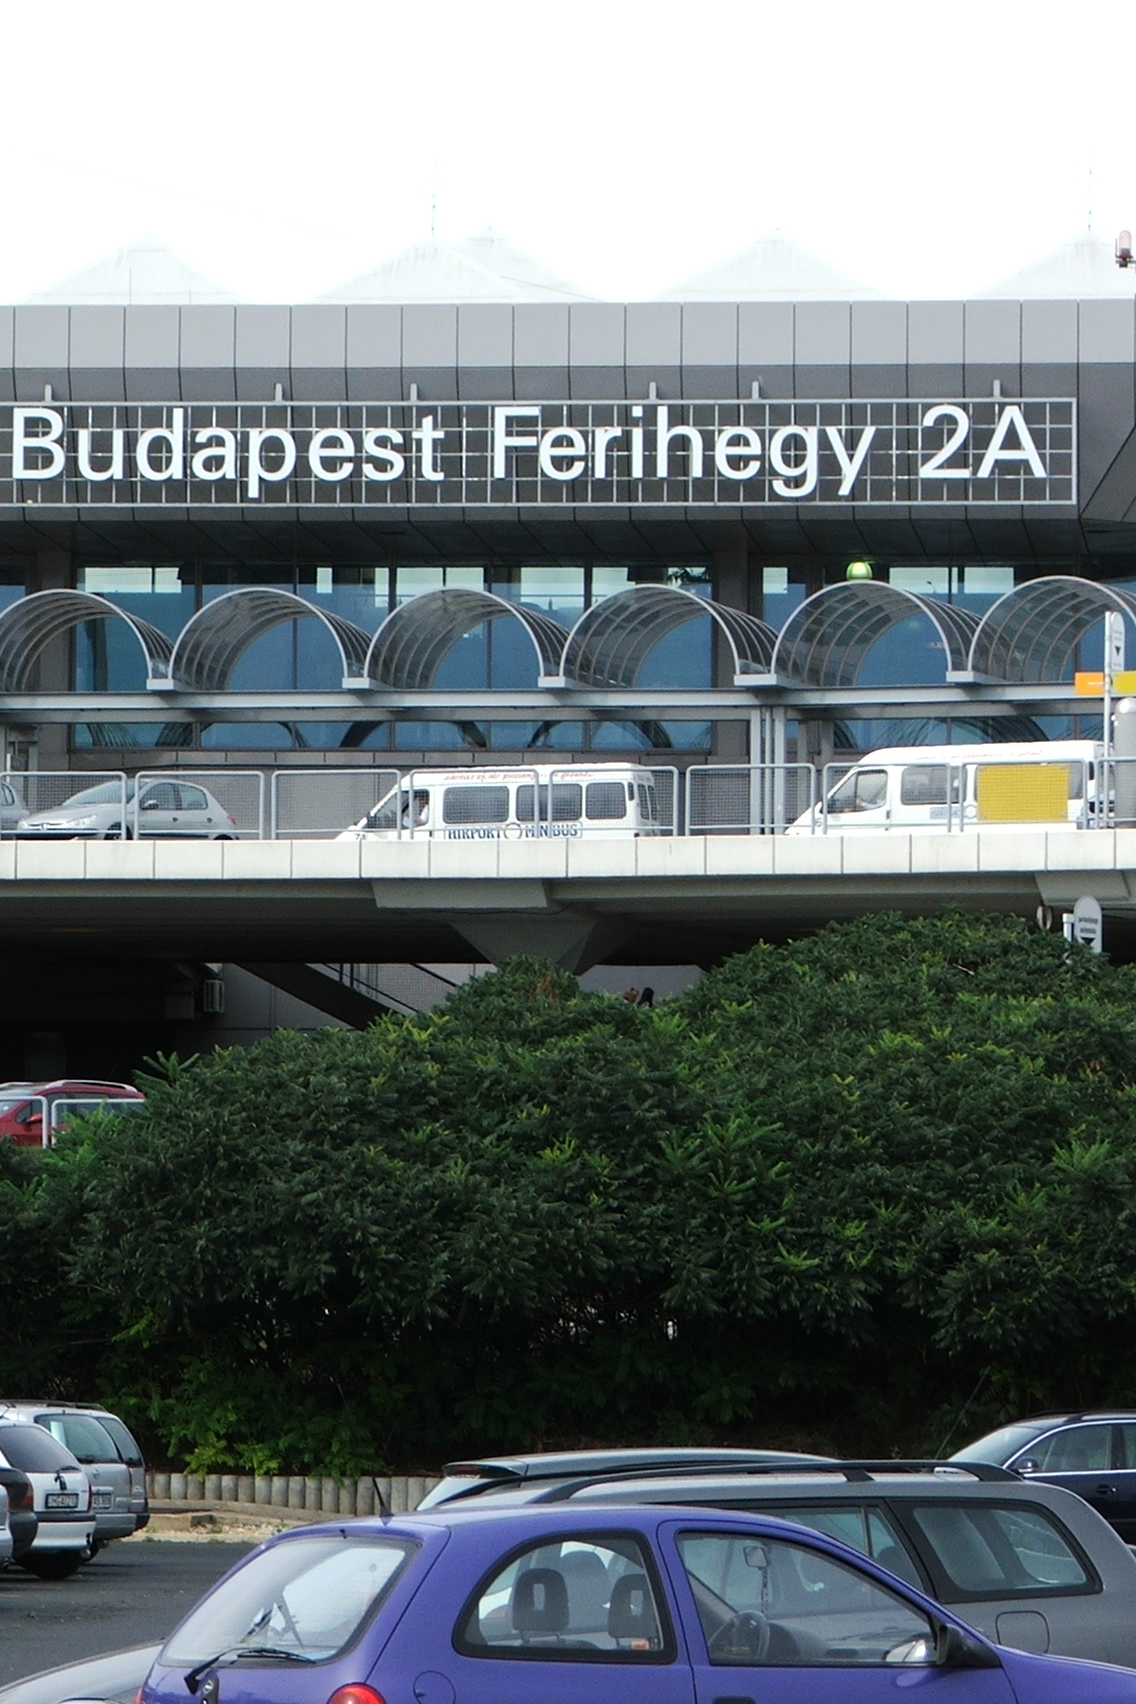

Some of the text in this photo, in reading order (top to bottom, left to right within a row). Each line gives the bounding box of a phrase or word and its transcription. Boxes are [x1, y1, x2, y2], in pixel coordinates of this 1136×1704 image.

[11, 404, 1048, 499] Budapest Ferihegy 2A
[524, 823, 578, 839] MNBUS
